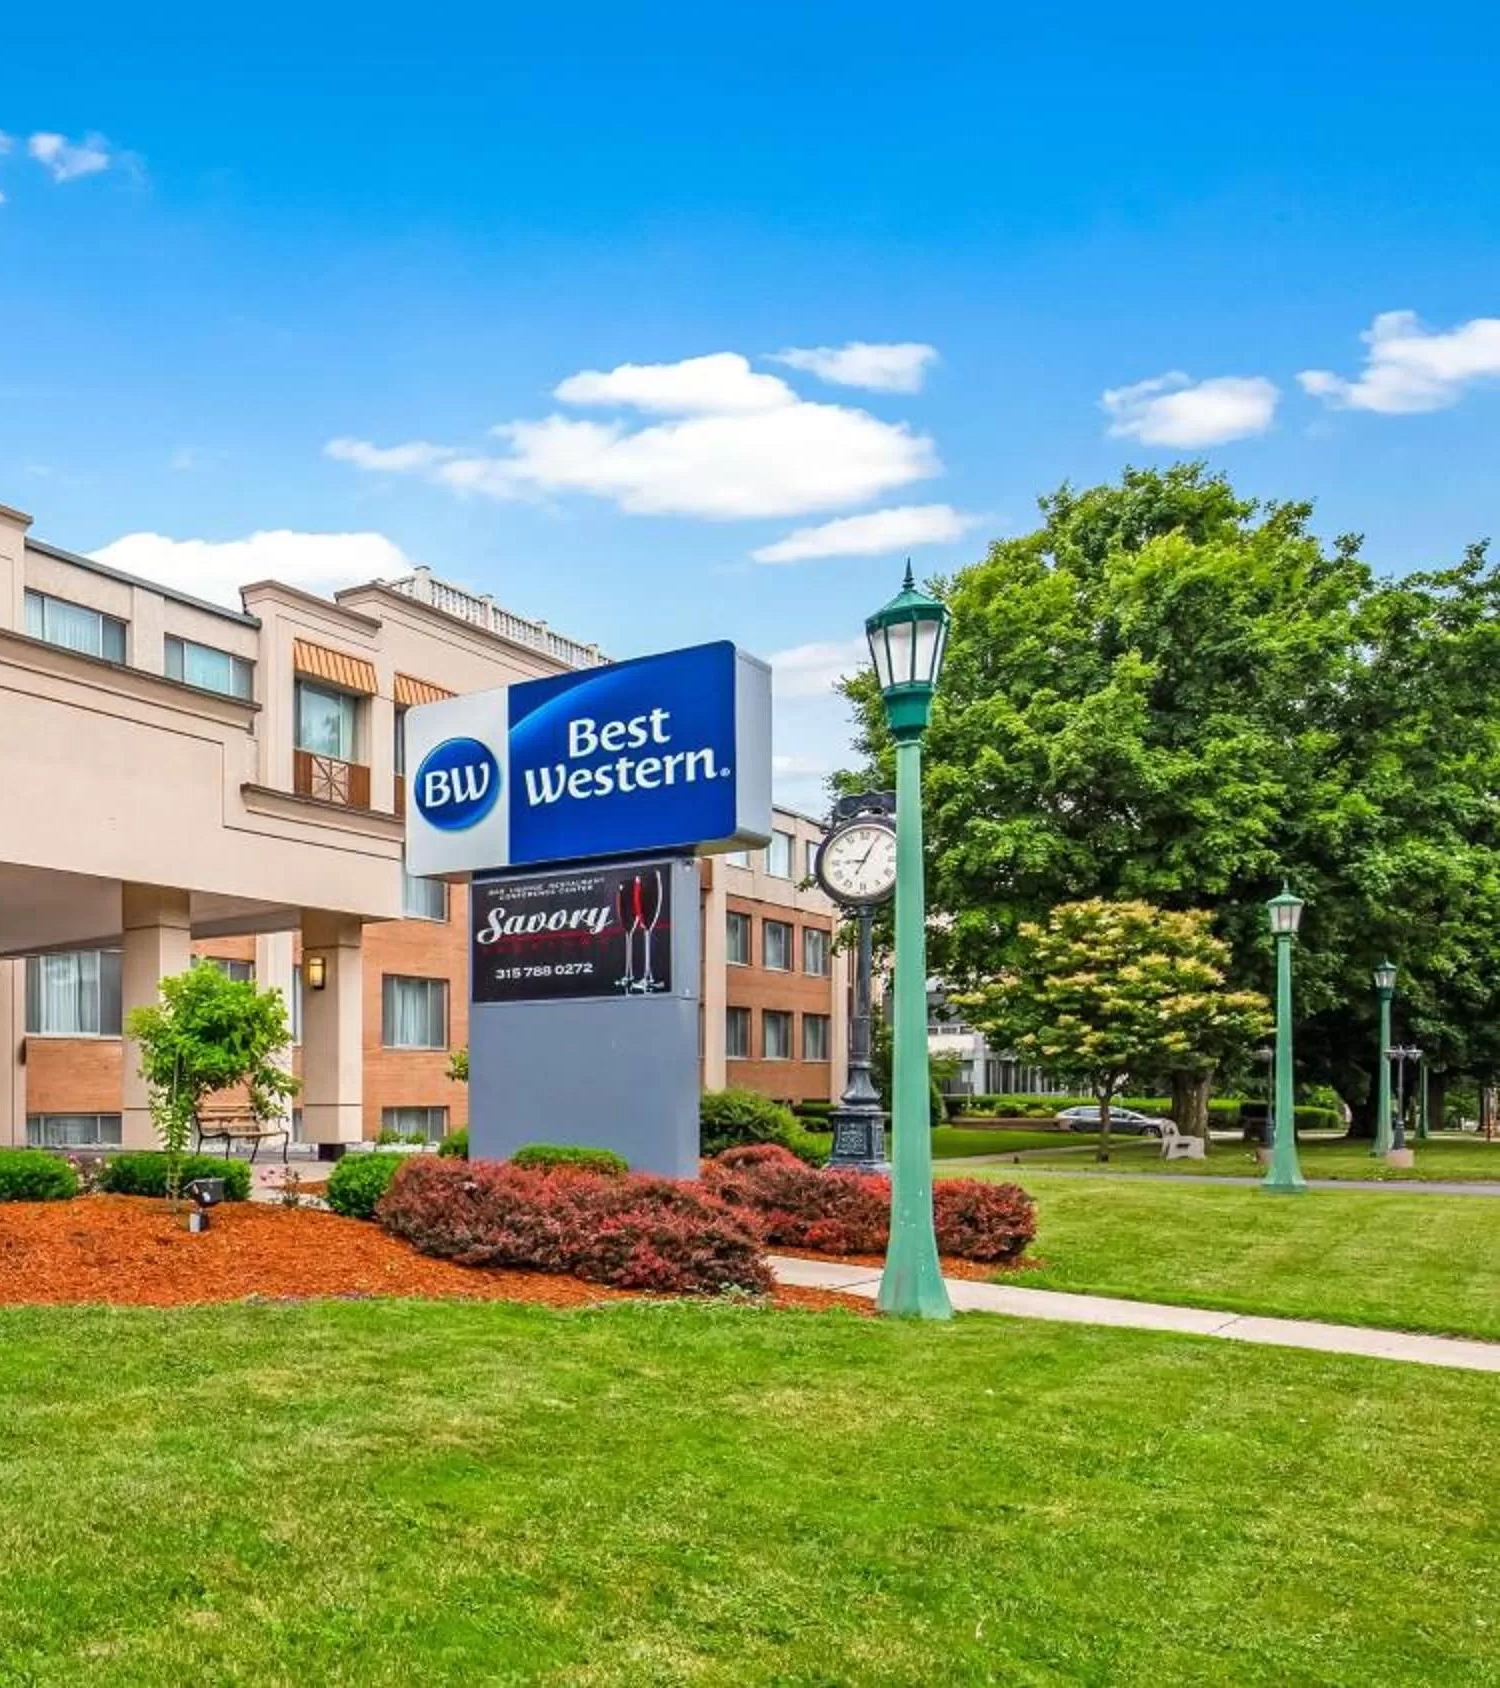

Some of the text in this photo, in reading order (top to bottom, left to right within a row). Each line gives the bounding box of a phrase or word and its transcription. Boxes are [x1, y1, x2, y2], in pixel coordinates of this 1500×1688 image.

[568, 707, 672, 758] Best
[425, 761, 490, 808] BW
[524, 747, 718, 807] Western
[477, 905, 613, 945] Savory
[495, 962, 594, 980] 315 788 0272
